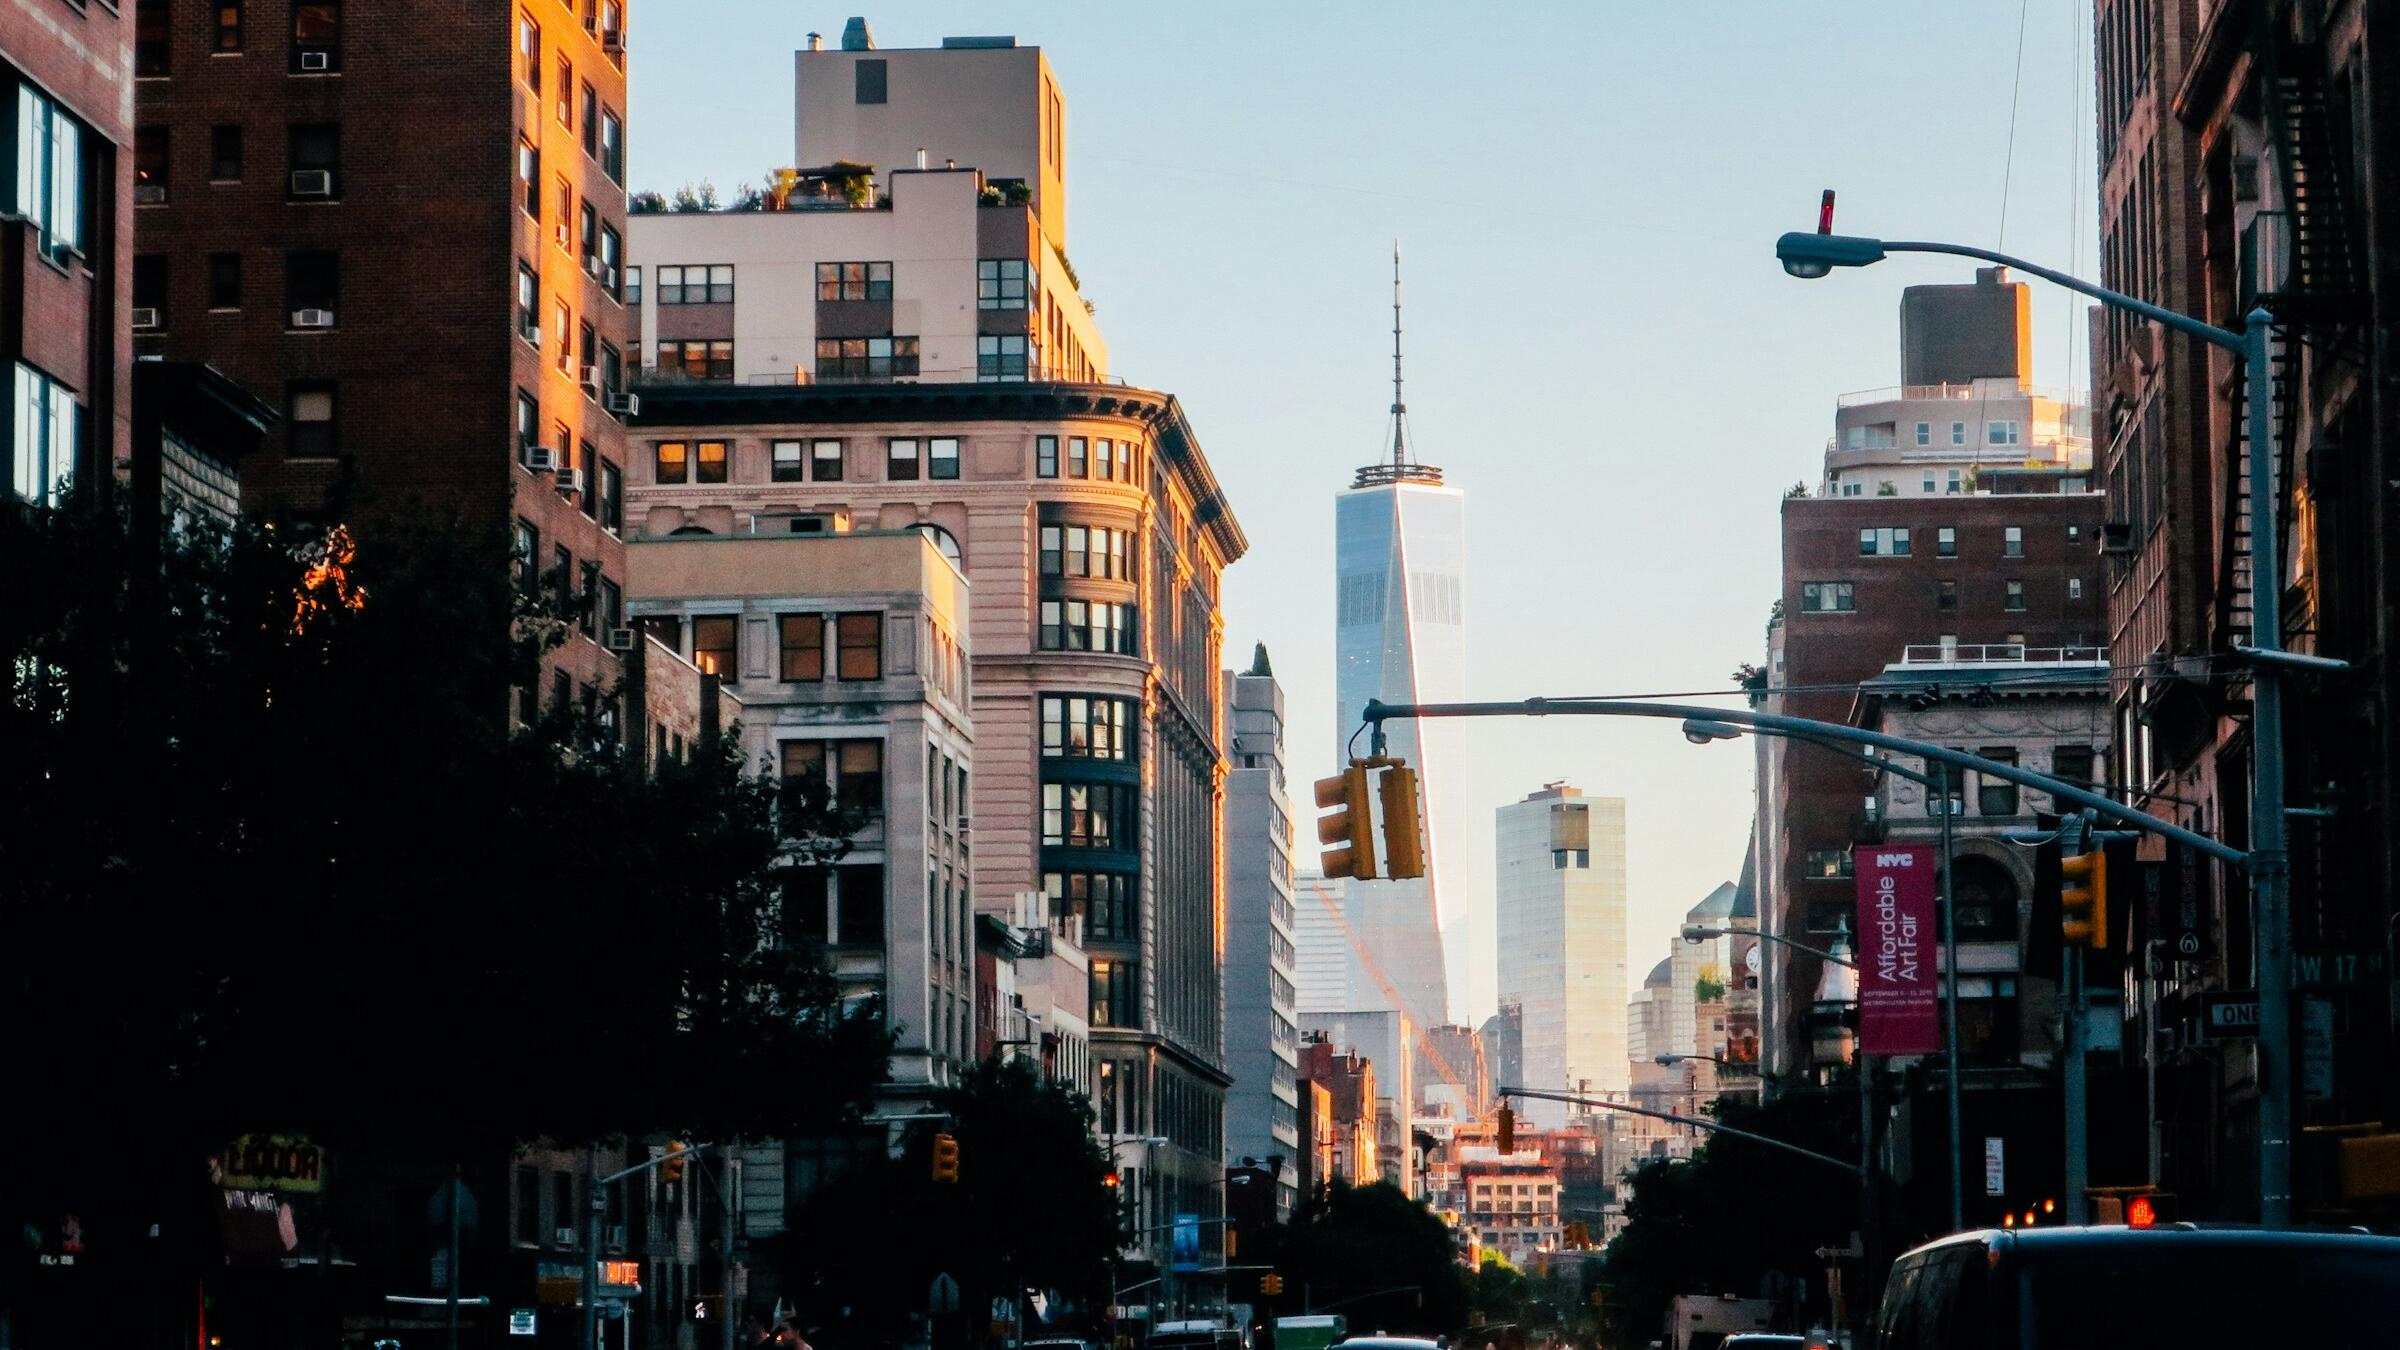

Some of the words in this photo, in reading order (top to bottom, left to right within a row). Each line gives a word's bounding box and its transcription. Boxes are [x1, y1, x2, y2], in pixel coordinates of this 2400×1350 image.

[1876, 854, 1914, 868] NYC
[1876, 876, 1898, 983] Affordable
[1898, 912, 1918, 949] Fair
[1898, 949, 1918, 982] Art
[2301, 954, 2322, 982] W
[2335, 954, 2358, 982] 17
[2222, 1005, 2260, 1024] ONE
